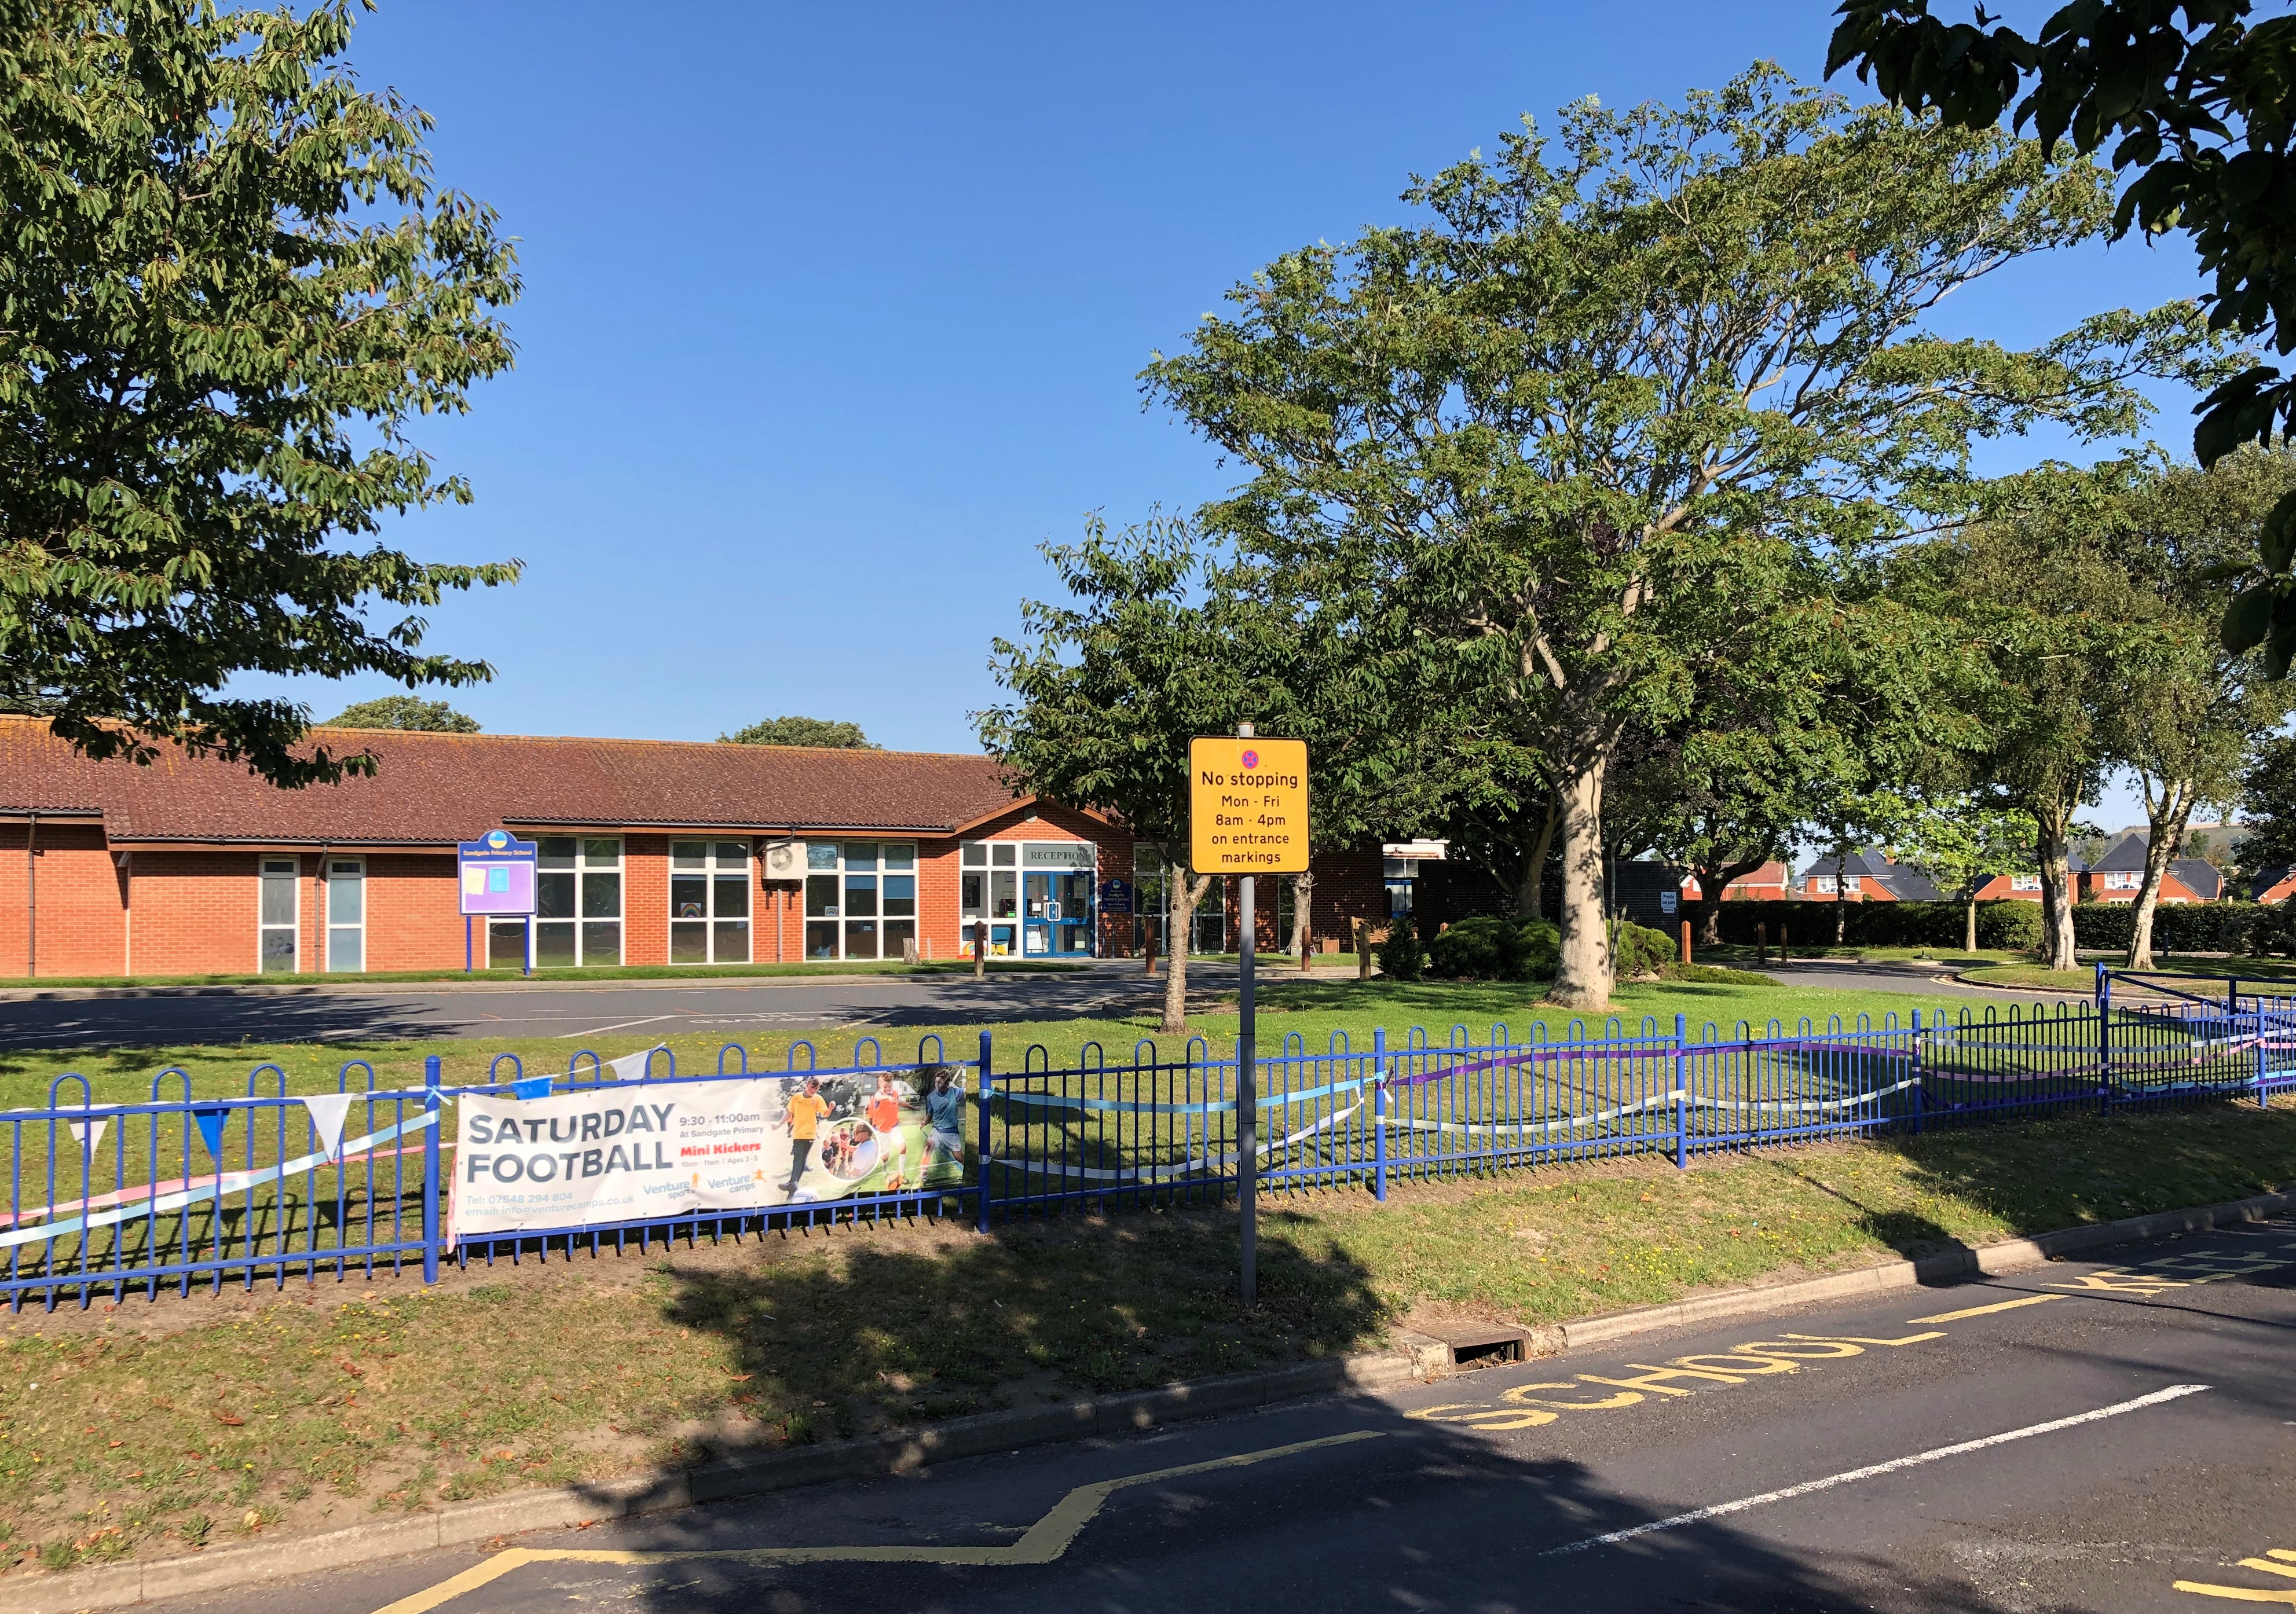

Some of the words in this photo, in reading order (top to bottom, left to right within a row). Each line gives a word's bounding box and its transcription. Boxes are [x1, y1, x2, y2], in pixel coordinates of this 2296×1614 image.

[1202, 771, 1224, 785] No
[1231, 772, 1298, 788] stopping
[1222, 795, 1248, 807] Mon
[1264, 795, 1280, 807] Fri
[1215, 814, 1243, 826] 8am
[1257, 815, 1286, 827] 4pm
[1212, 835, 1227, 844] on
[1232, 833, 1290, 844] entrance
[1222, 851, 1281, 864] markings
[468, 1103, 676, 1145] SATURDAY
[680, 1116, 706, 1126] 9:30
[715, 1113, 760, 1124] 11:00am
[691, 1128, 731, 1138] Sandgate
[733, 1126, 764, 1135] Primary
[680, 1144, 710, 1157] Mini
[713, 1142, 761, 1154] Kickers
[467, 1141, 673, 1183] FOOTBALL
[727, 1157, 744, 1165] Ages
[642, 1181, 690, 1195] Venture
[706, 1175, 750, 1190] Venture
[730, 1183, 756, 1194] camps
[466, 1195, 485, 1204] Tel:
[489, 1195, 524, 1204] 07548
[528, 1194, 549, 1203] 294
[552, 1192, 573, 1201] 804
[668, 1189, 696, 1200] sports
[465, 1208, 498, 1216] email:
[501, 1195, 635, 1215] info@venturecamps.co.uk
[1402, 1332, 1949, 1430] SCHOOL
[2039, 1251, 2295, 1294] KEEP
